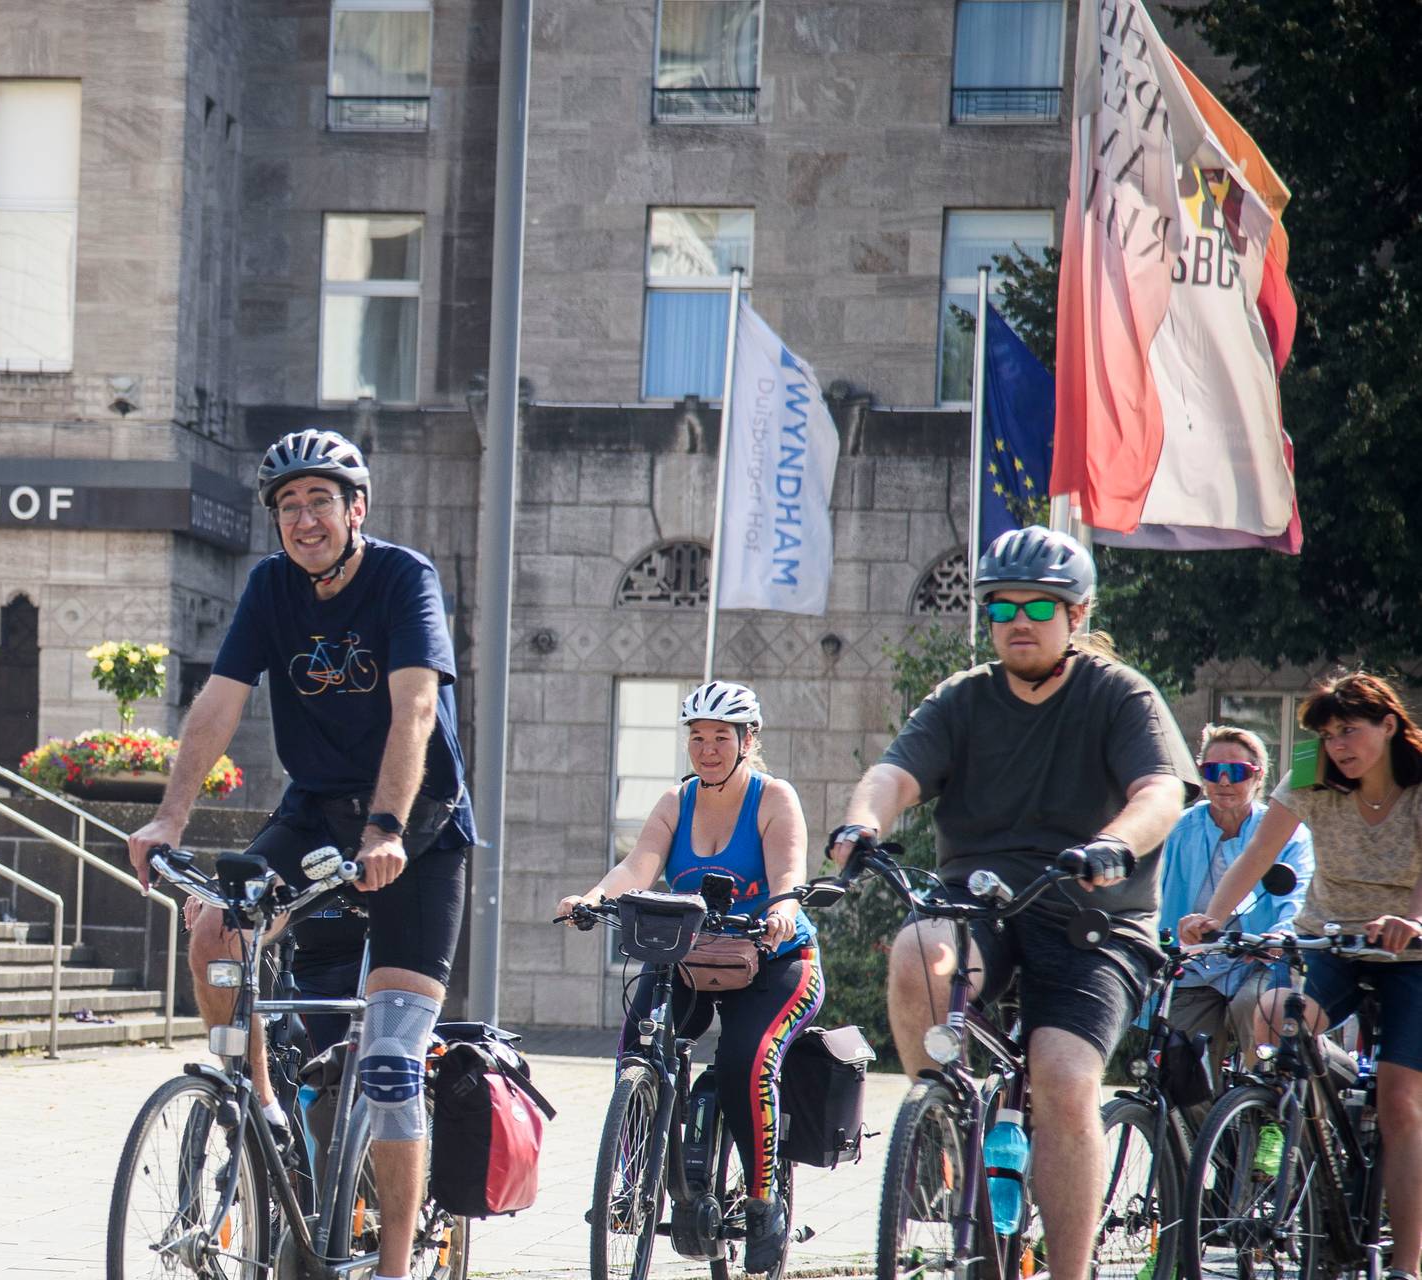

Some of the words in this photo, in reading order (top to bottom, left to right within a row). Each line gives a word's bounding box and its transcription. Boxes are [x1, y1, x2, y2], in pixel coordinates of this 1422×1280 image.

[746, 378, 774, 505] Duisburger
[772, 382, 809, 588] WYNDHAM
[744, 512, 763, 554] Hof
[782, 964, 820, 1032] ZUMBA
[759, 1037, 785, 1112] ZUMBA
